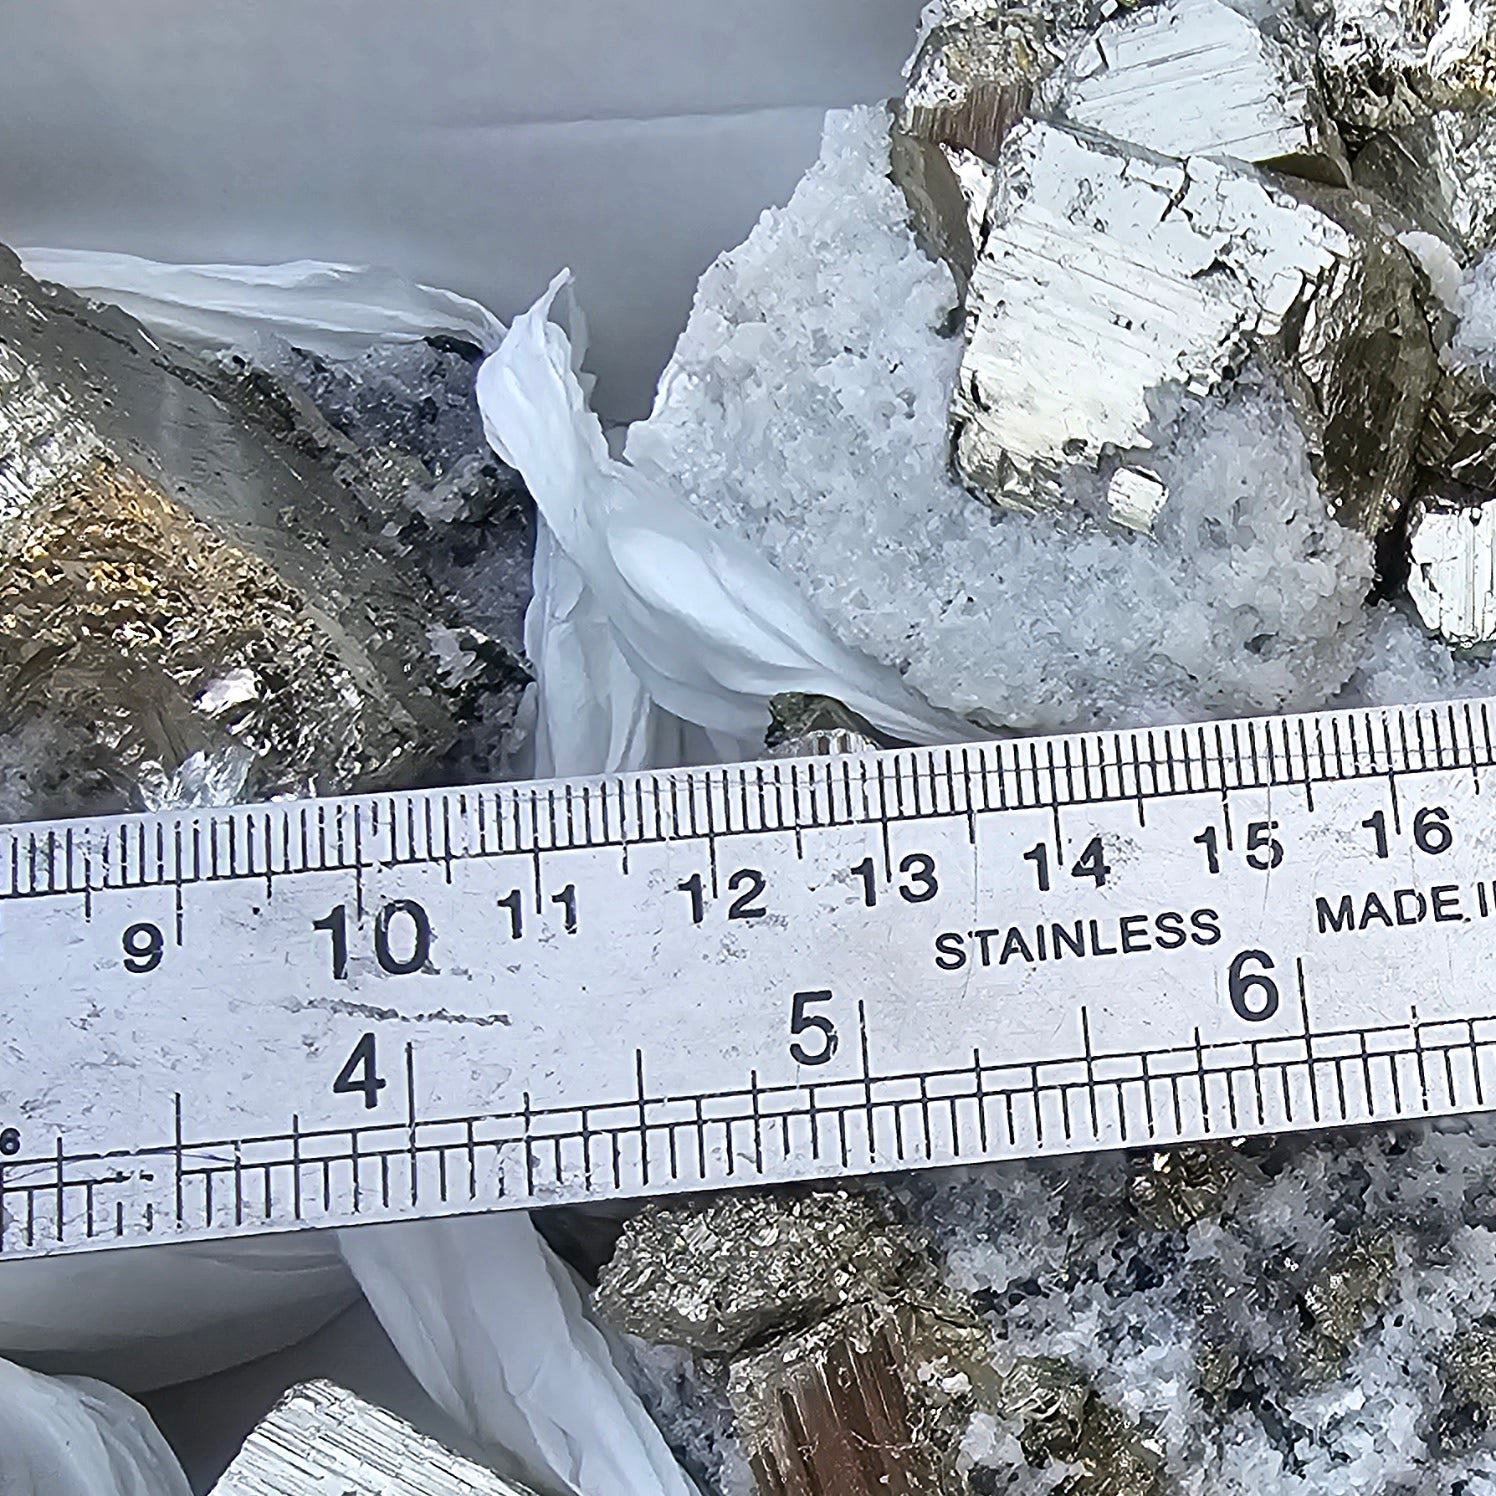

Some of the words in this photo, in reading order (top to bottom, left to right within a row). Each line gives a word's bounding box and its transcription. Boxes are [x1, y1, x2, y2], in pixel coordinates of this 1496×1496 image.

[122, 922, 164, 973] 9
[313, 899, 431, 979] 10
[498, 884, 578, 939] 11
[678, 869, 766, 923] 12
[851, 853, 938, 906] 13
[1024, 837, 1111, 891] 14
[1194, 820, 1283, 873] 15
[1362, 806, 1452, 858] 16
[935, 908, 1221, 970] STAINLESS
[1316, 884, 1463, 933] MADE
[333, 1032, 386, 1108] 4
[789, 990, 837, 1065] 5
[1228, 950, 1279, 1021] 6
